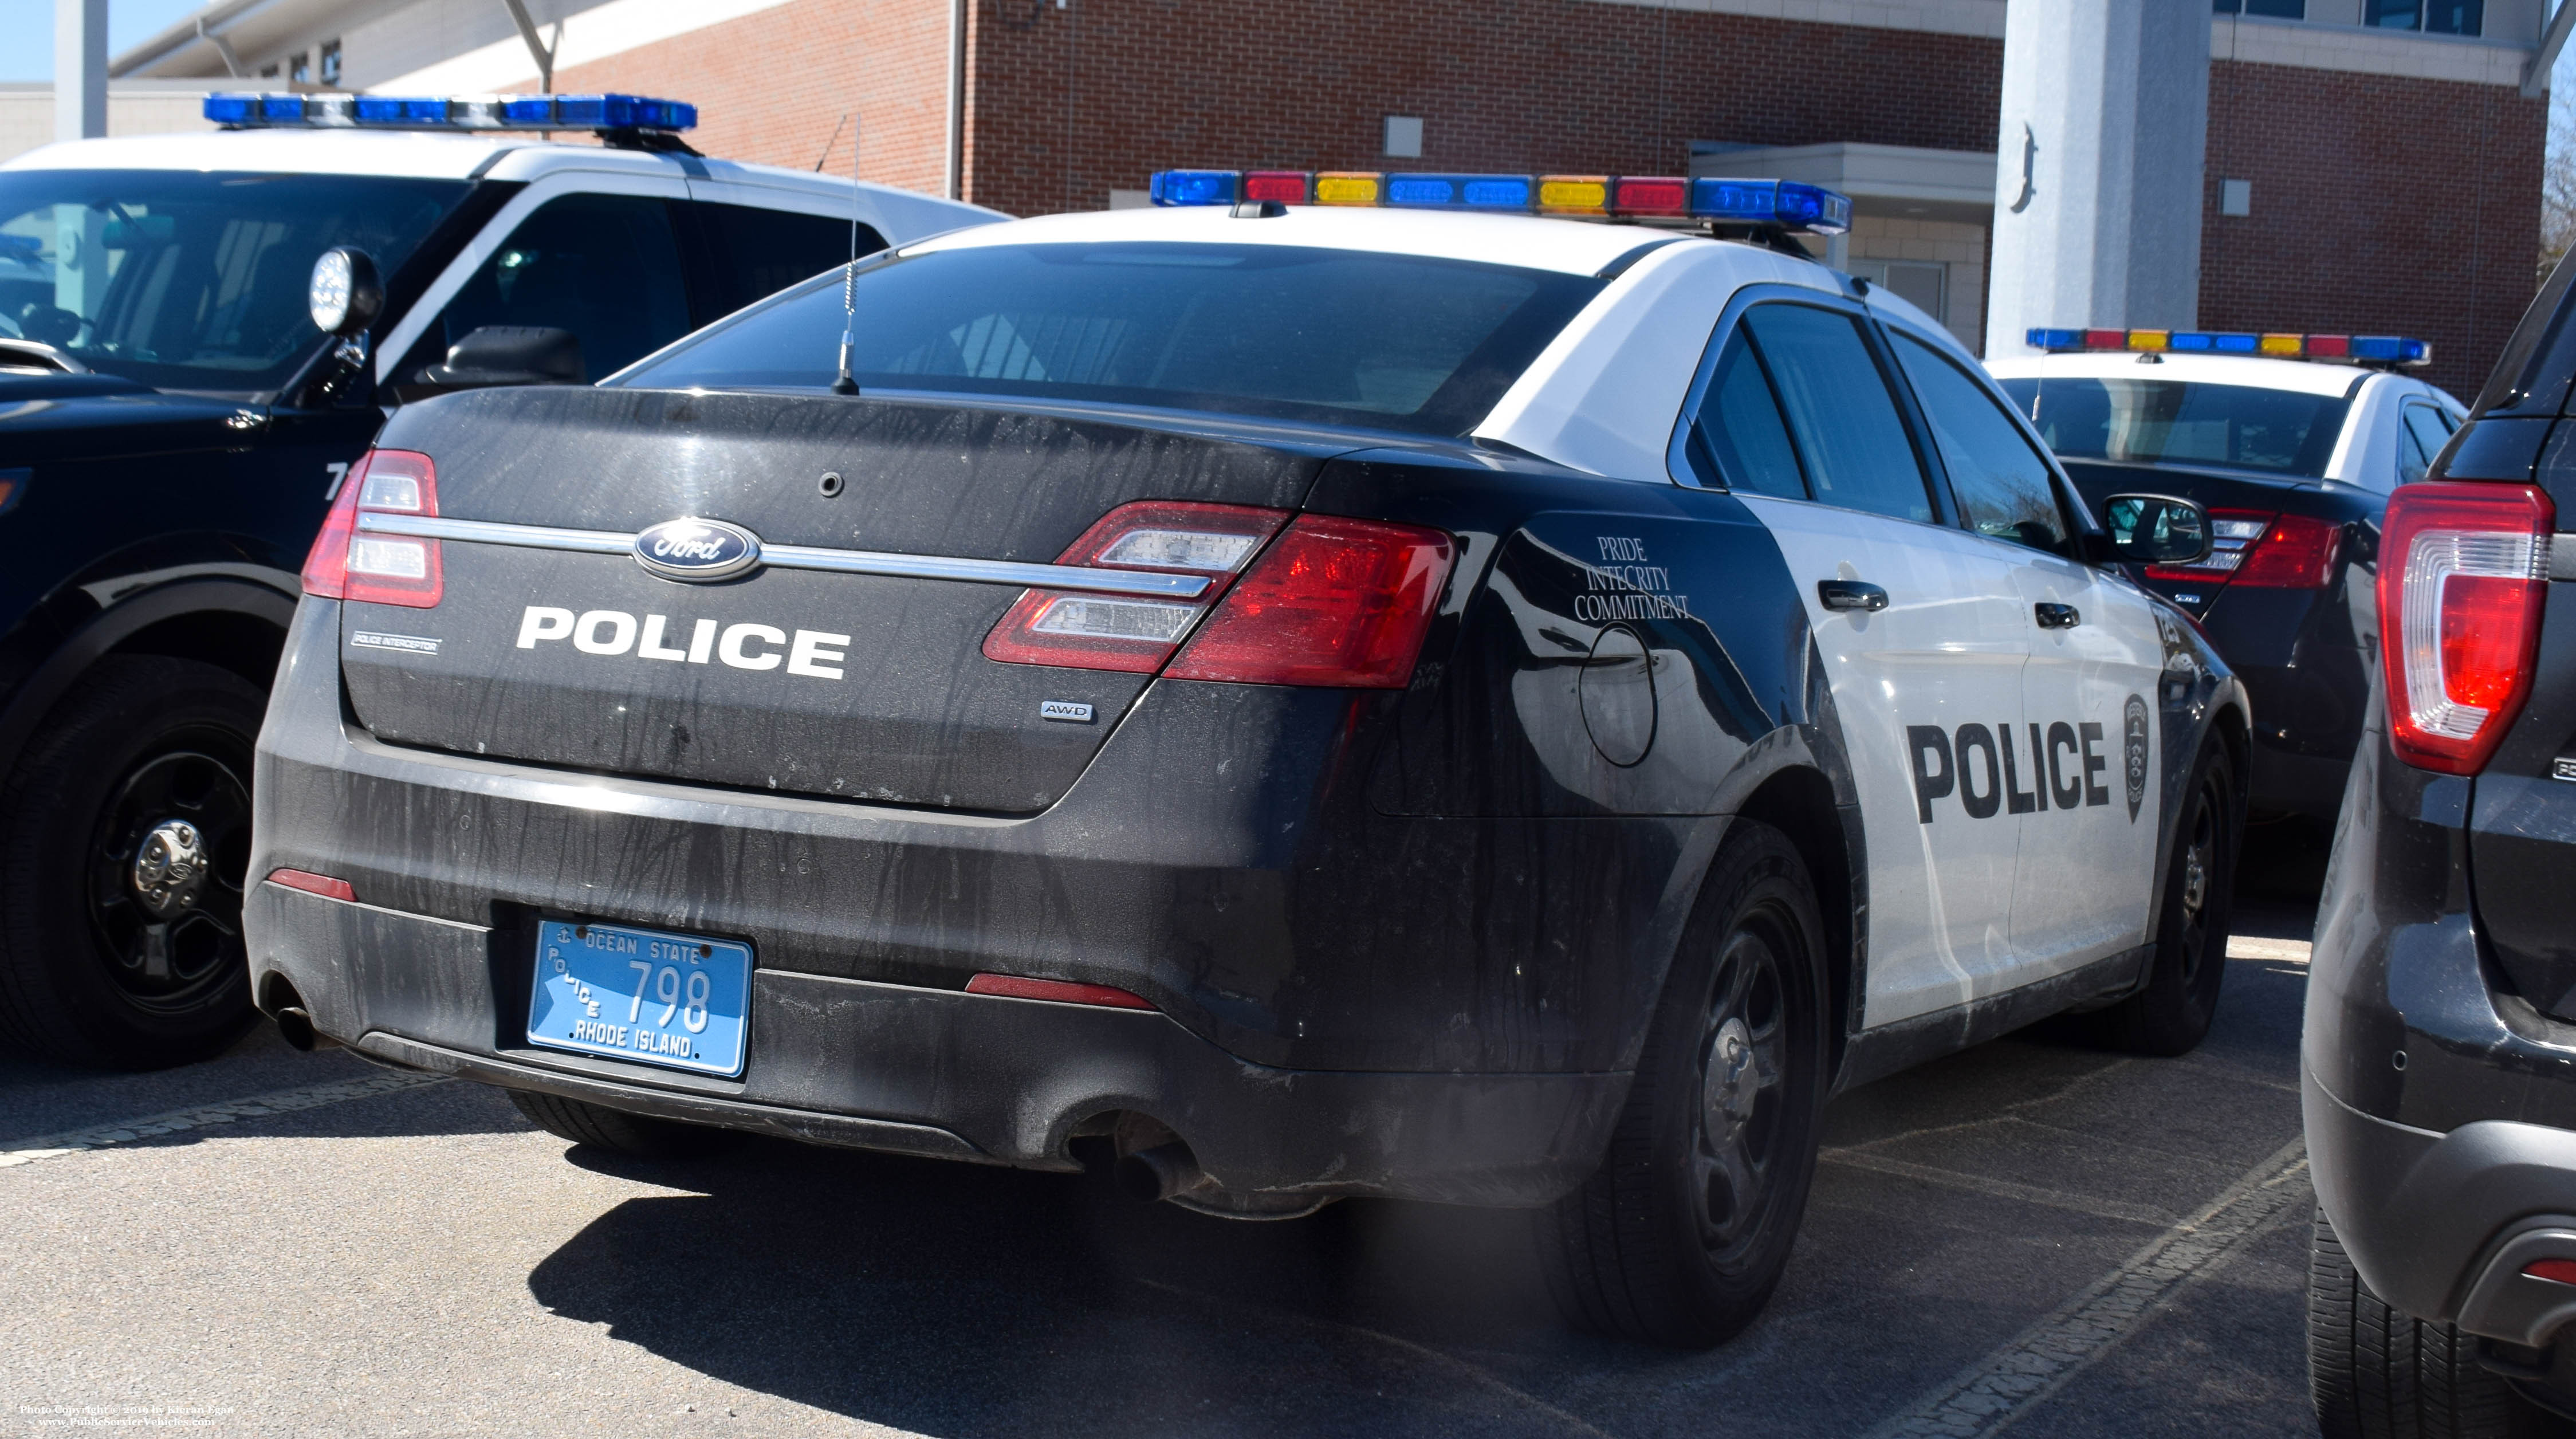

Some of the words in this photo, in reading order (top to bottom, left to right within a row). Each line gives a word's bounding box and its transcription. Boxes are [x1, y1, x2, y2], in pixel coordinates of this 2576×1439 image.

[654, 526, 726, 560] Ford
[1596, 536, 1647, 561] PRIDE
[1585, 565, 1670, 591] INTEGRITY
[1575, 595, 1690, 620] COMMITMENT
[354, 634, 382, 645] POLICE
[382, 637, 437, 651] INTERCEPTOR
[516, 606, 851, 680] POLICE
[1044, 705, 1087, 715] AWD
[1906, 721, 2109, 824] POLICE
[585, 931, 636, 954] OCEAN
[650, 941, 701, 965] STATE
[548, 945, 600, 1018] POLICE
[629, 960, 711, 1033] 798
[575, 1020, 629, 1048] RHODE
[634, 1029, 691, 1059] ISLAND
